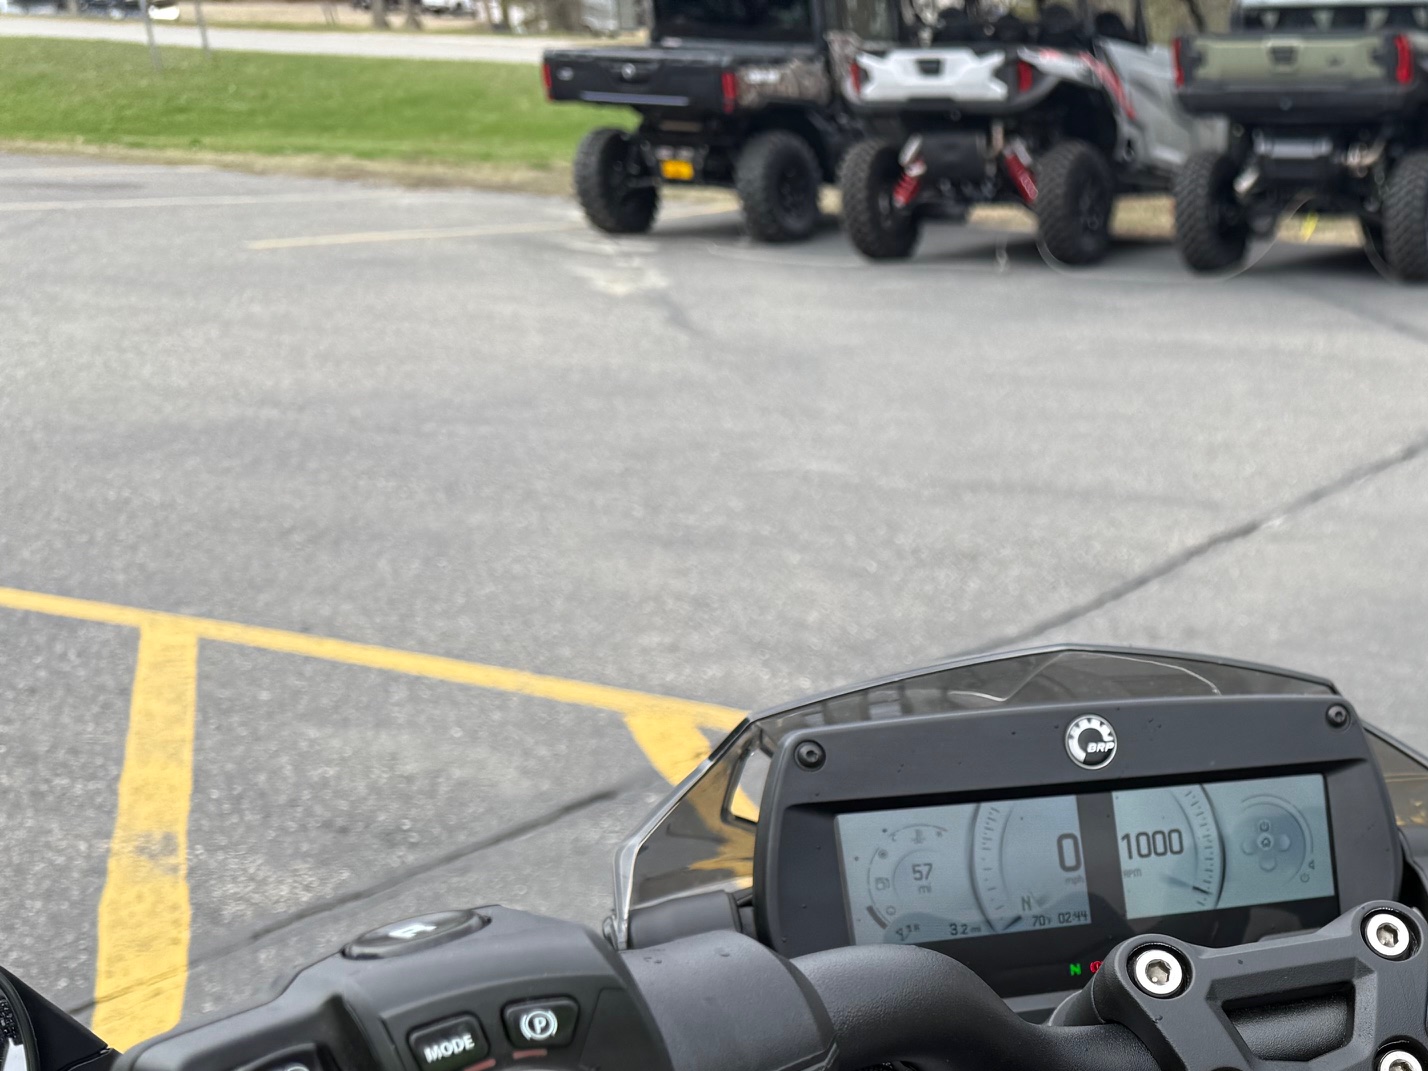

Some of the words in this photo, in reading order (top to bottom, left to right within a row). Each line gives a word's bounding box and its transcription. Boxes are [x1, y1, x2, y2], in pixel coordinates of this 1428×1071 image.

[1087, 741, 1115, 753] BRP
[1056, 832, 1082, 873] 0
[1121, 828, 1184, 860] 1000
[911, 862, 933, 881] 57
[1065, 874, 1085, 886] mph
[1021, 895, 1032, 912] N
[1069, 963, 1082, 976] N
[423, 1033, 475, 1063] MODE
